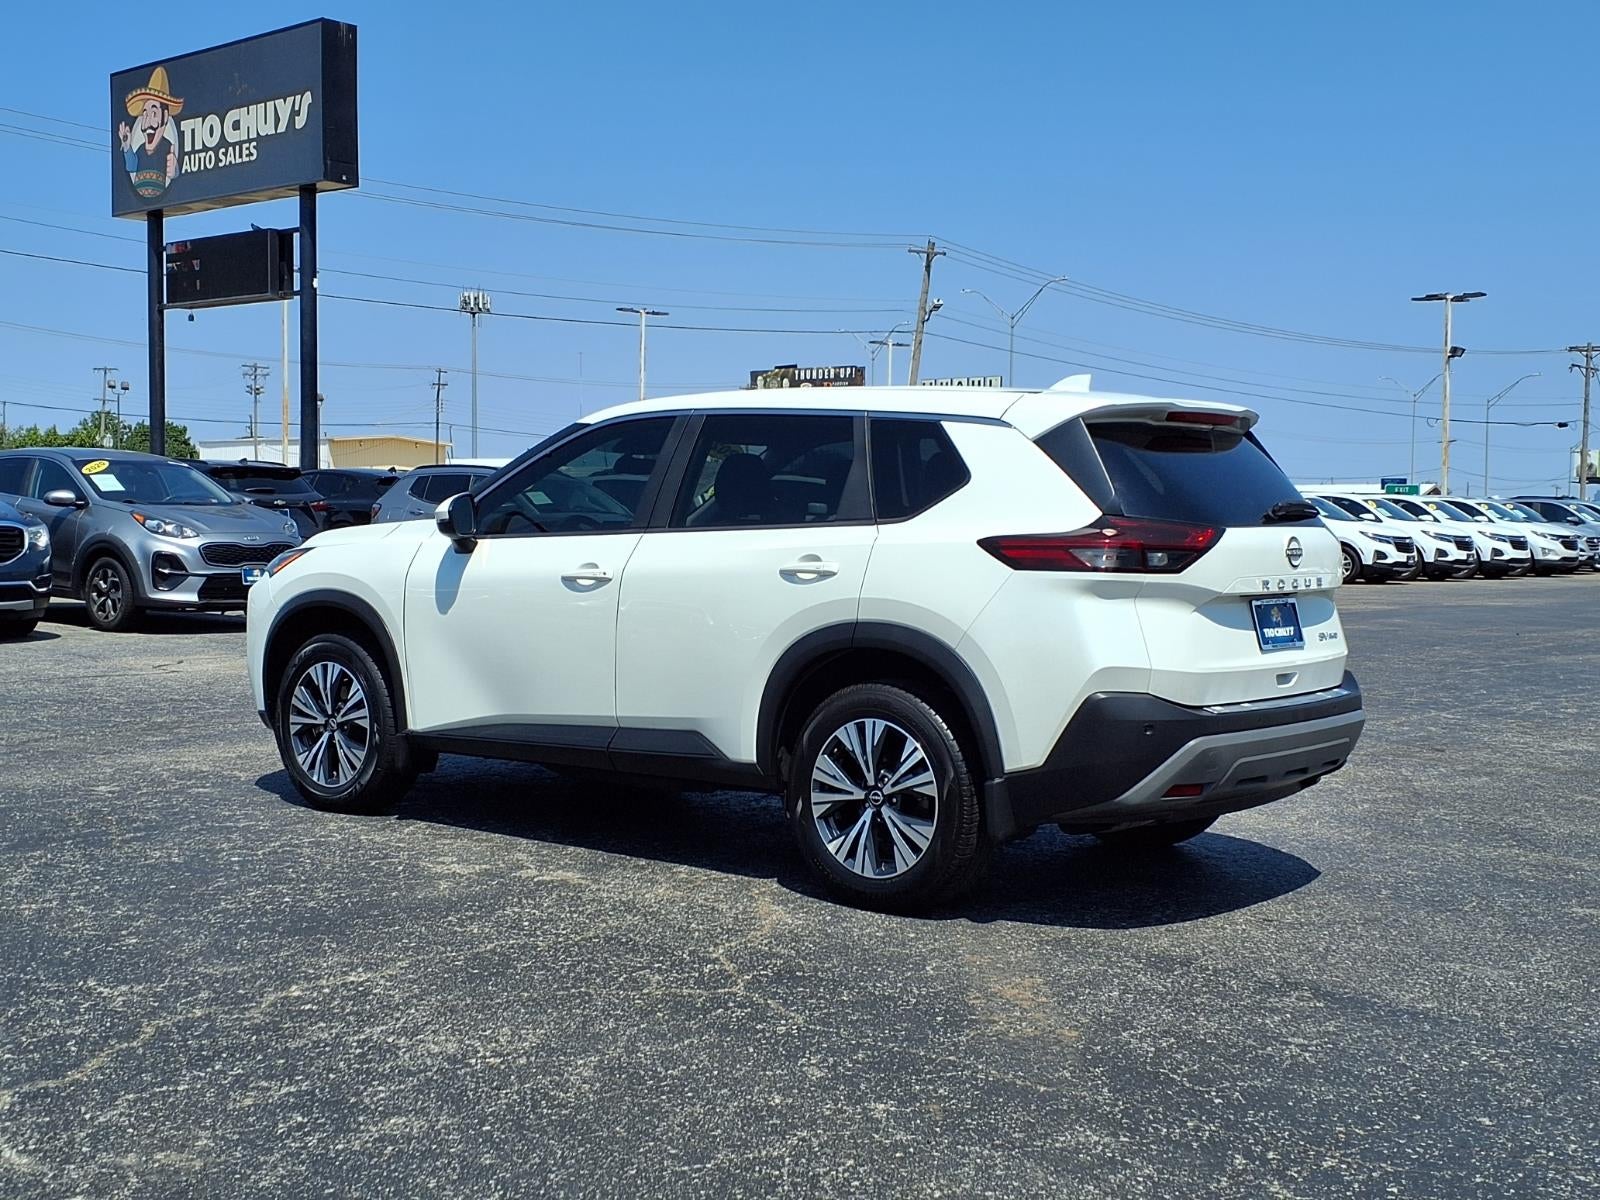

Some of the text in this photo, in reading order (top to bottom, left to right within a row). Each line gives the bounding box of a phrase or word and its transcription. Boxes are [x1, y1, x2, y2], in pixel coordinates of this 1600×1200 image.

[181, 91, 312, 152] TIO CHUY'S
[182, 141, 258, 174] AUTO SALES
[795, 367, 856, 380] THUNDER UP!
[1262, 577, 1322, 590] ROGUE
[1263, 628, 1275, 638] TIO
